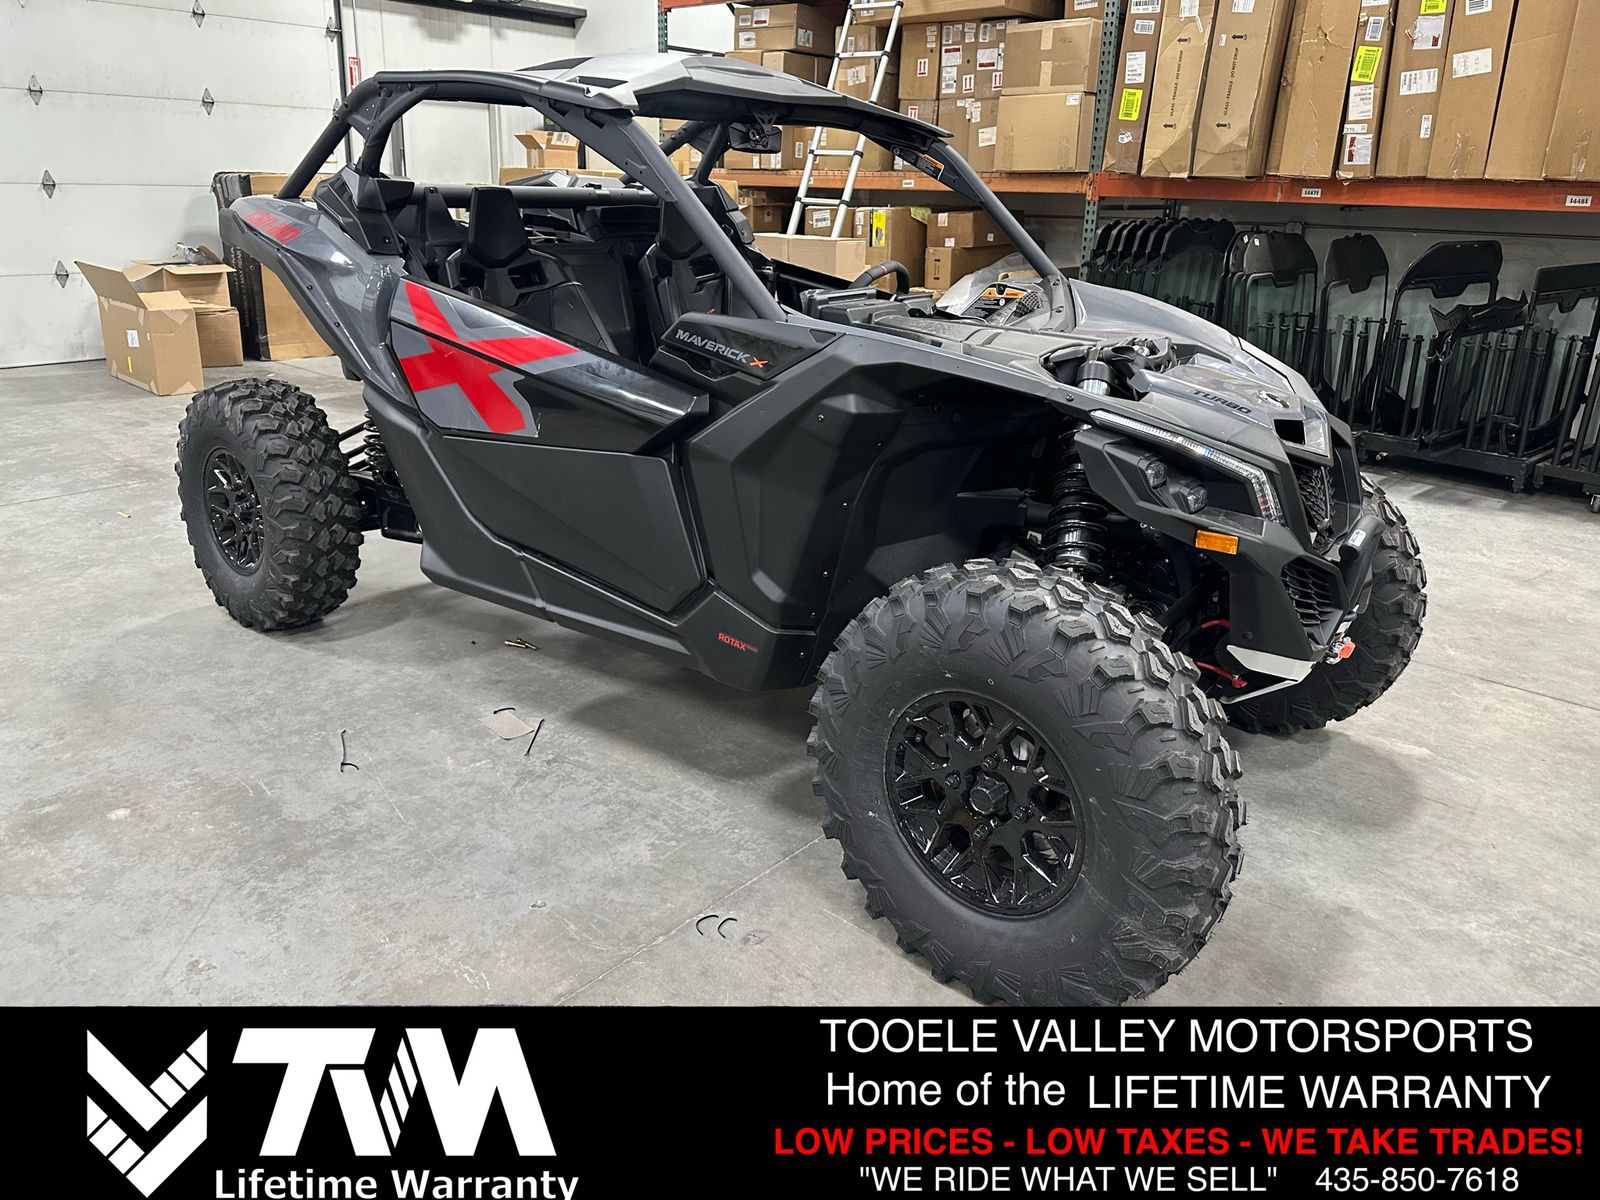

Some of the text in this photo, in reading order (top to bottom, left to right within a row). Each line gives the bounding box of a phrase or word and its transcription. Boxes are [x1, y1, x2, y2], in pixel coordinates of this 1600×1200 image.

[675, 328, 769, 369] MAVERICK X
[1192, 388, 1253, 415] TURBO
[718, 633, 746, 652] ROTAX
